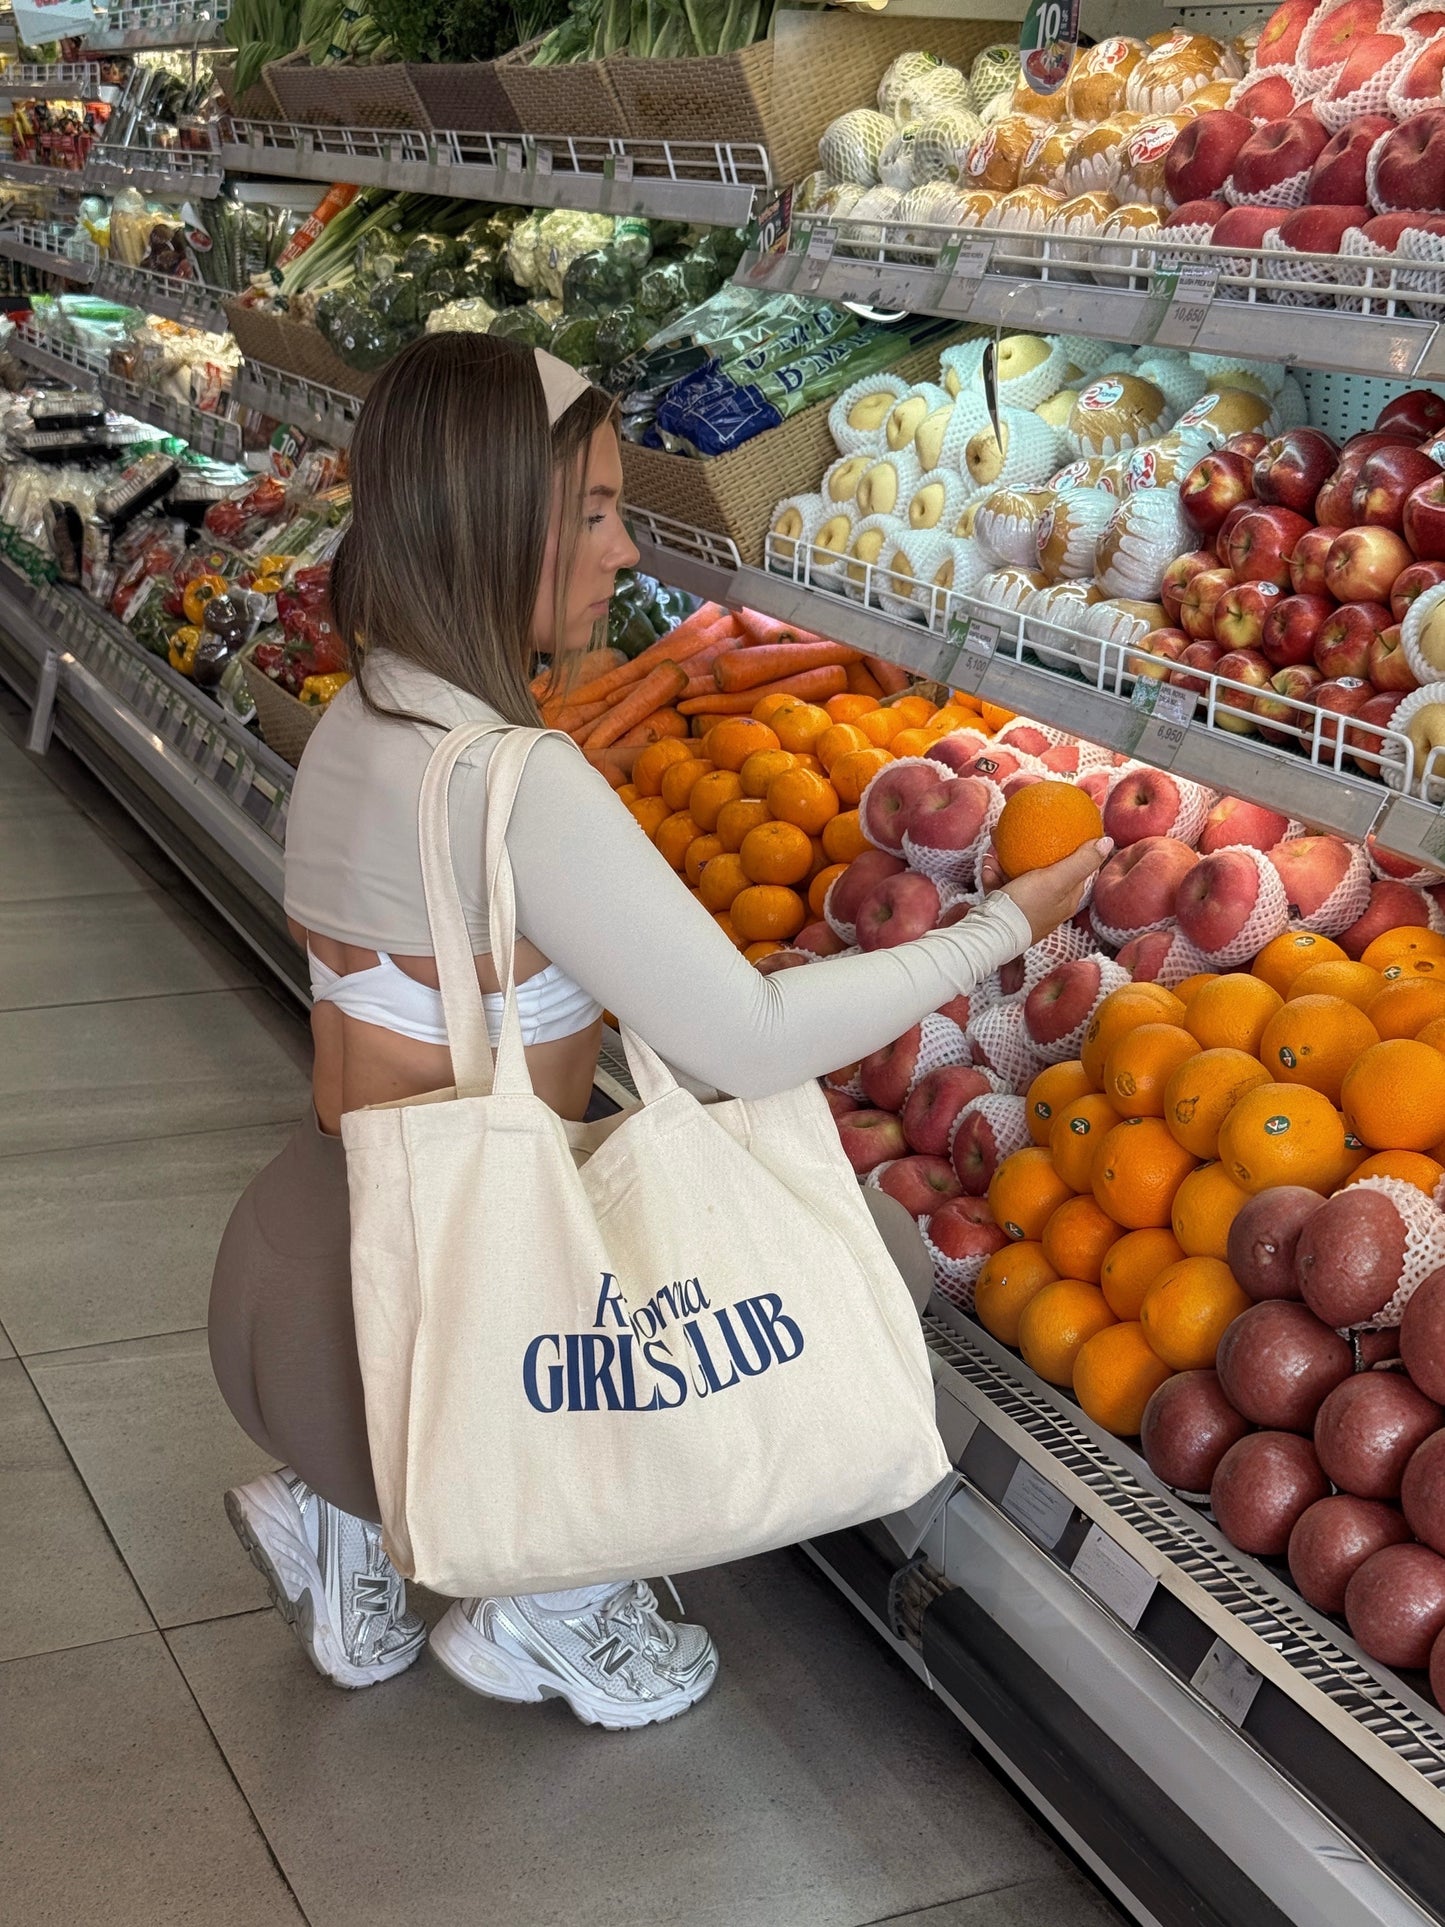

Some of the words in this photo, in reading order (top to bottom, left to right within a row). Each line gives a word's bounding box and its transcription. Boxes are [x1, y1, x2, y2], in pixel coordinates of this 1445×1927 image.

[1036, 3, 1061, 49] 10
[757, 222, 775, 255] 10
[1174, 306, 1205, 322] 10,650
[280, 432, 297, 457] 10
[965, 656, 987, 671] 5,100
[1157, 725, 1183, 743] 6,950
[592, 1271, 711, 1347] Rorma
[522, 1333, 688, 1413] GIRLS
[355, 1575, 389, 1613] N
[585, 1633, 637, 1677] N
